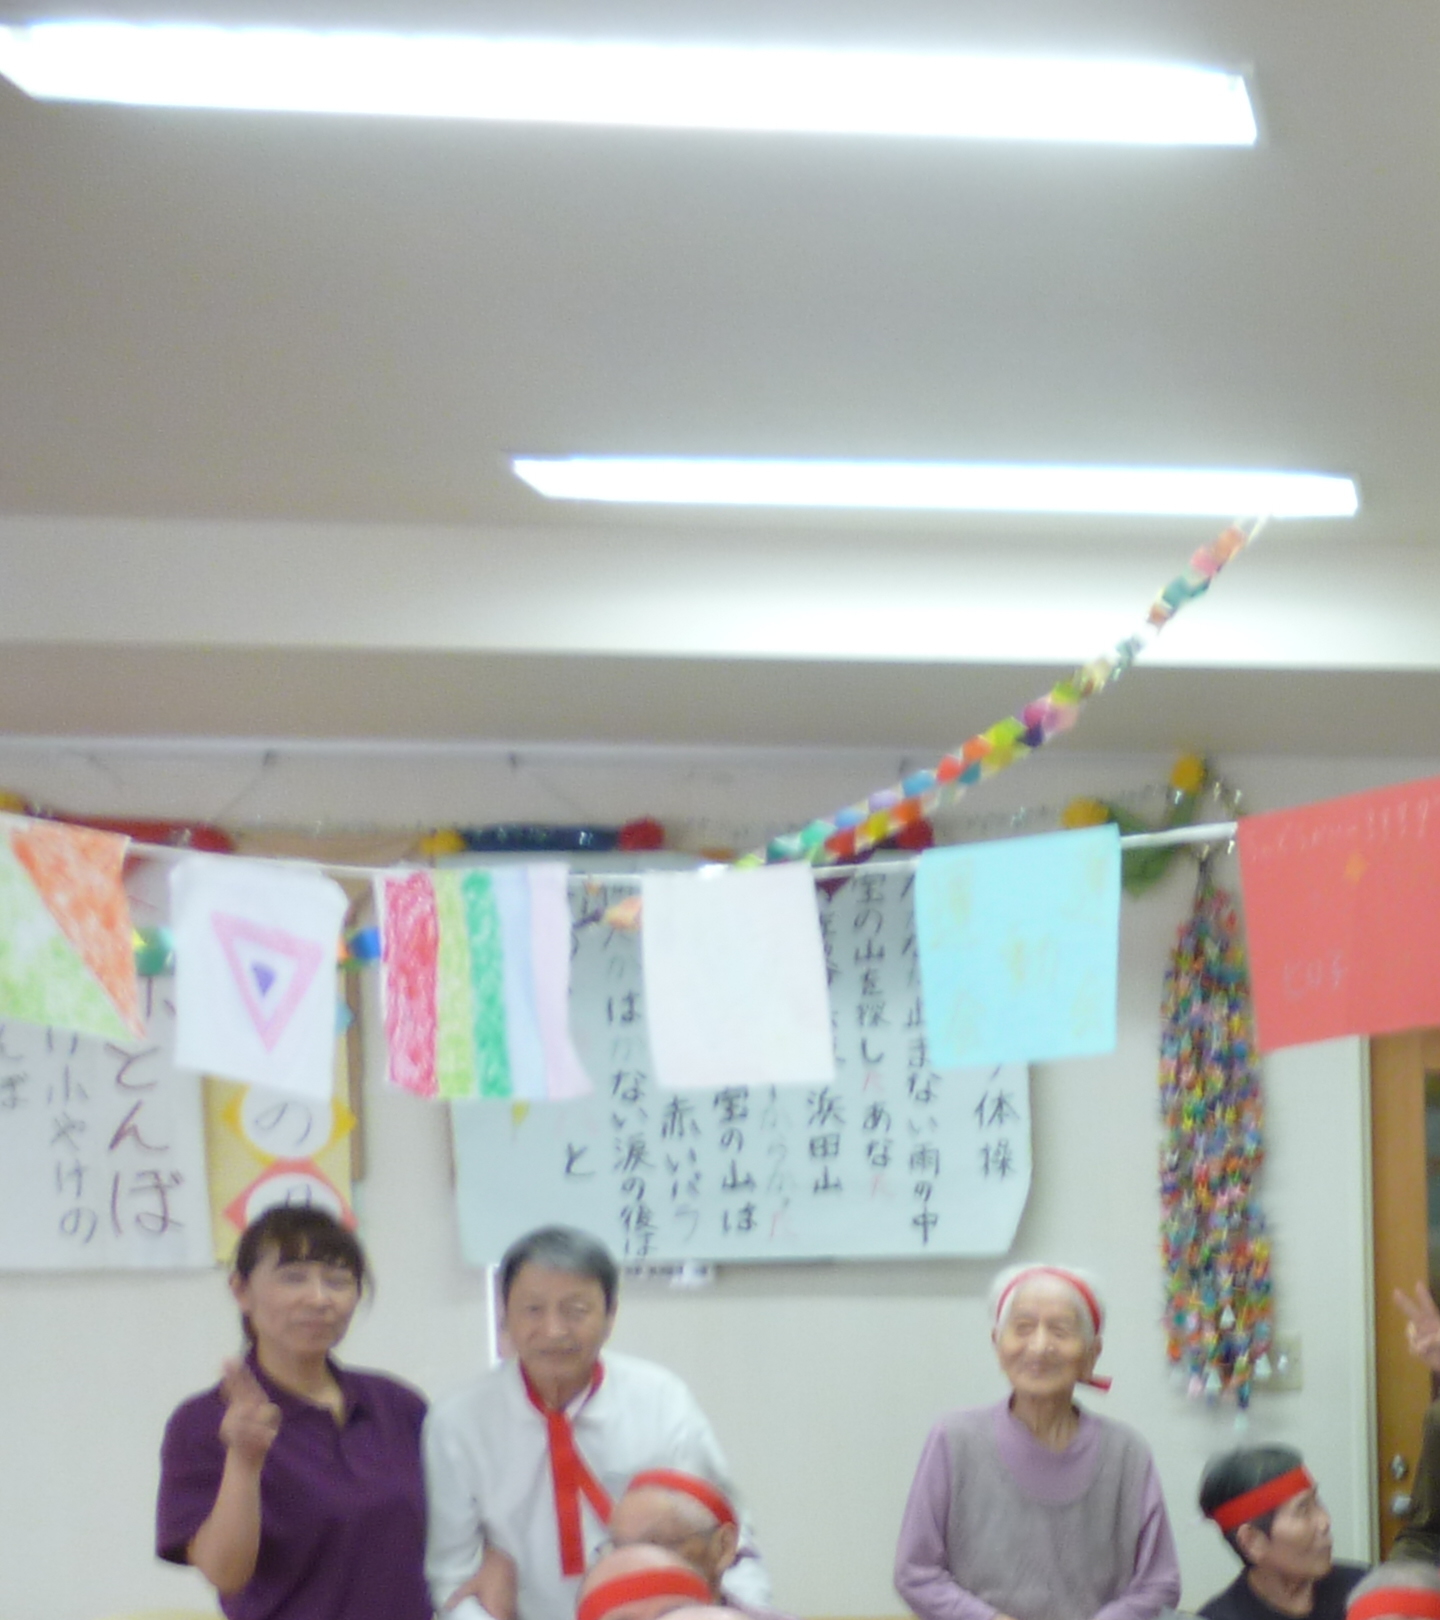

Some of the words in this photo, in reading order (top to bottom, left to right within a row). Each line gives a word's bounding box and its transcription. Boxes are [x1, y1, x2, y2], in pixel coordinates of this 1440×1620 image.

[104, 978, 184, 1237] とんぼ
[974, 1064, 1020, 1180] 体操
